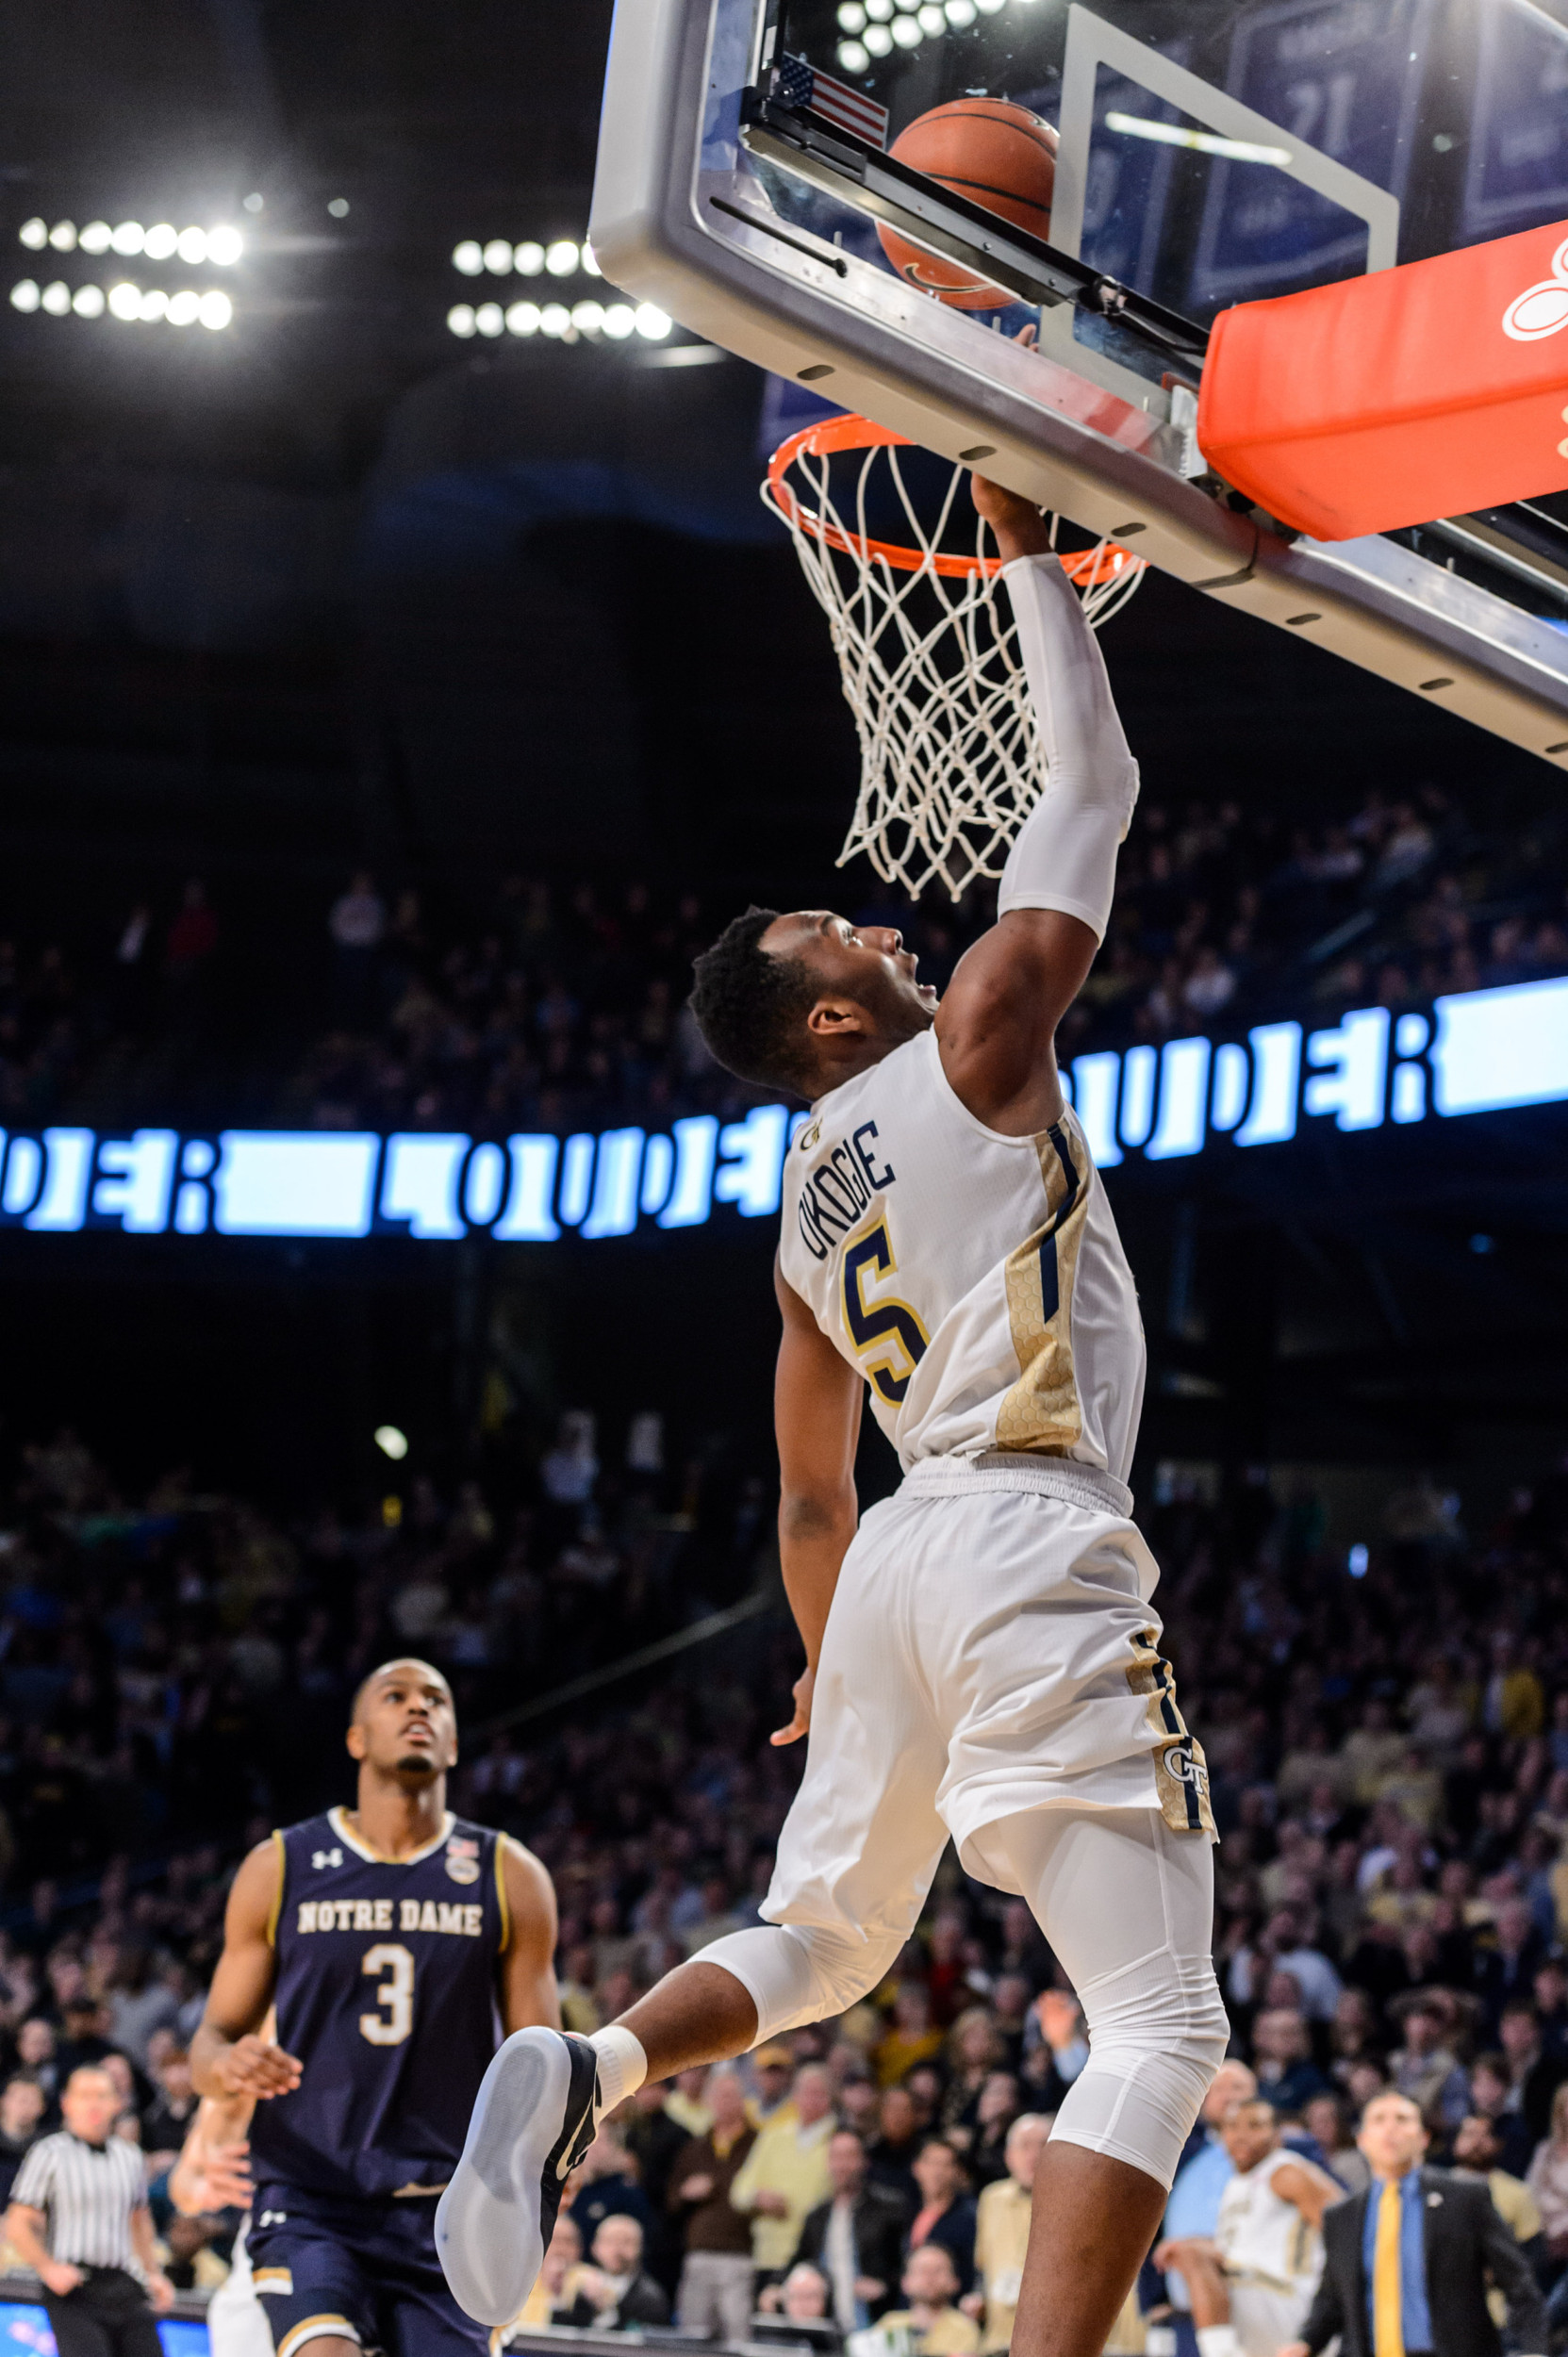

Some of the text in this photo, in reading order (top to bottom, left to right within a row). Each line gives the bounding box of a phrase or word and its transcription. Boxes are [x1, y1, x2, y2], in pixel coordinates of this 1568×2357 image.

[799, 1120, 896, 1261] OKOGIE
[840, 1214, 931, 1409] 5
[1164, 1746, 1208, 1795] GT
[297, 1899, 483, 1937] NOTRE DAME
[359, 1943, 415, 2046] 3
